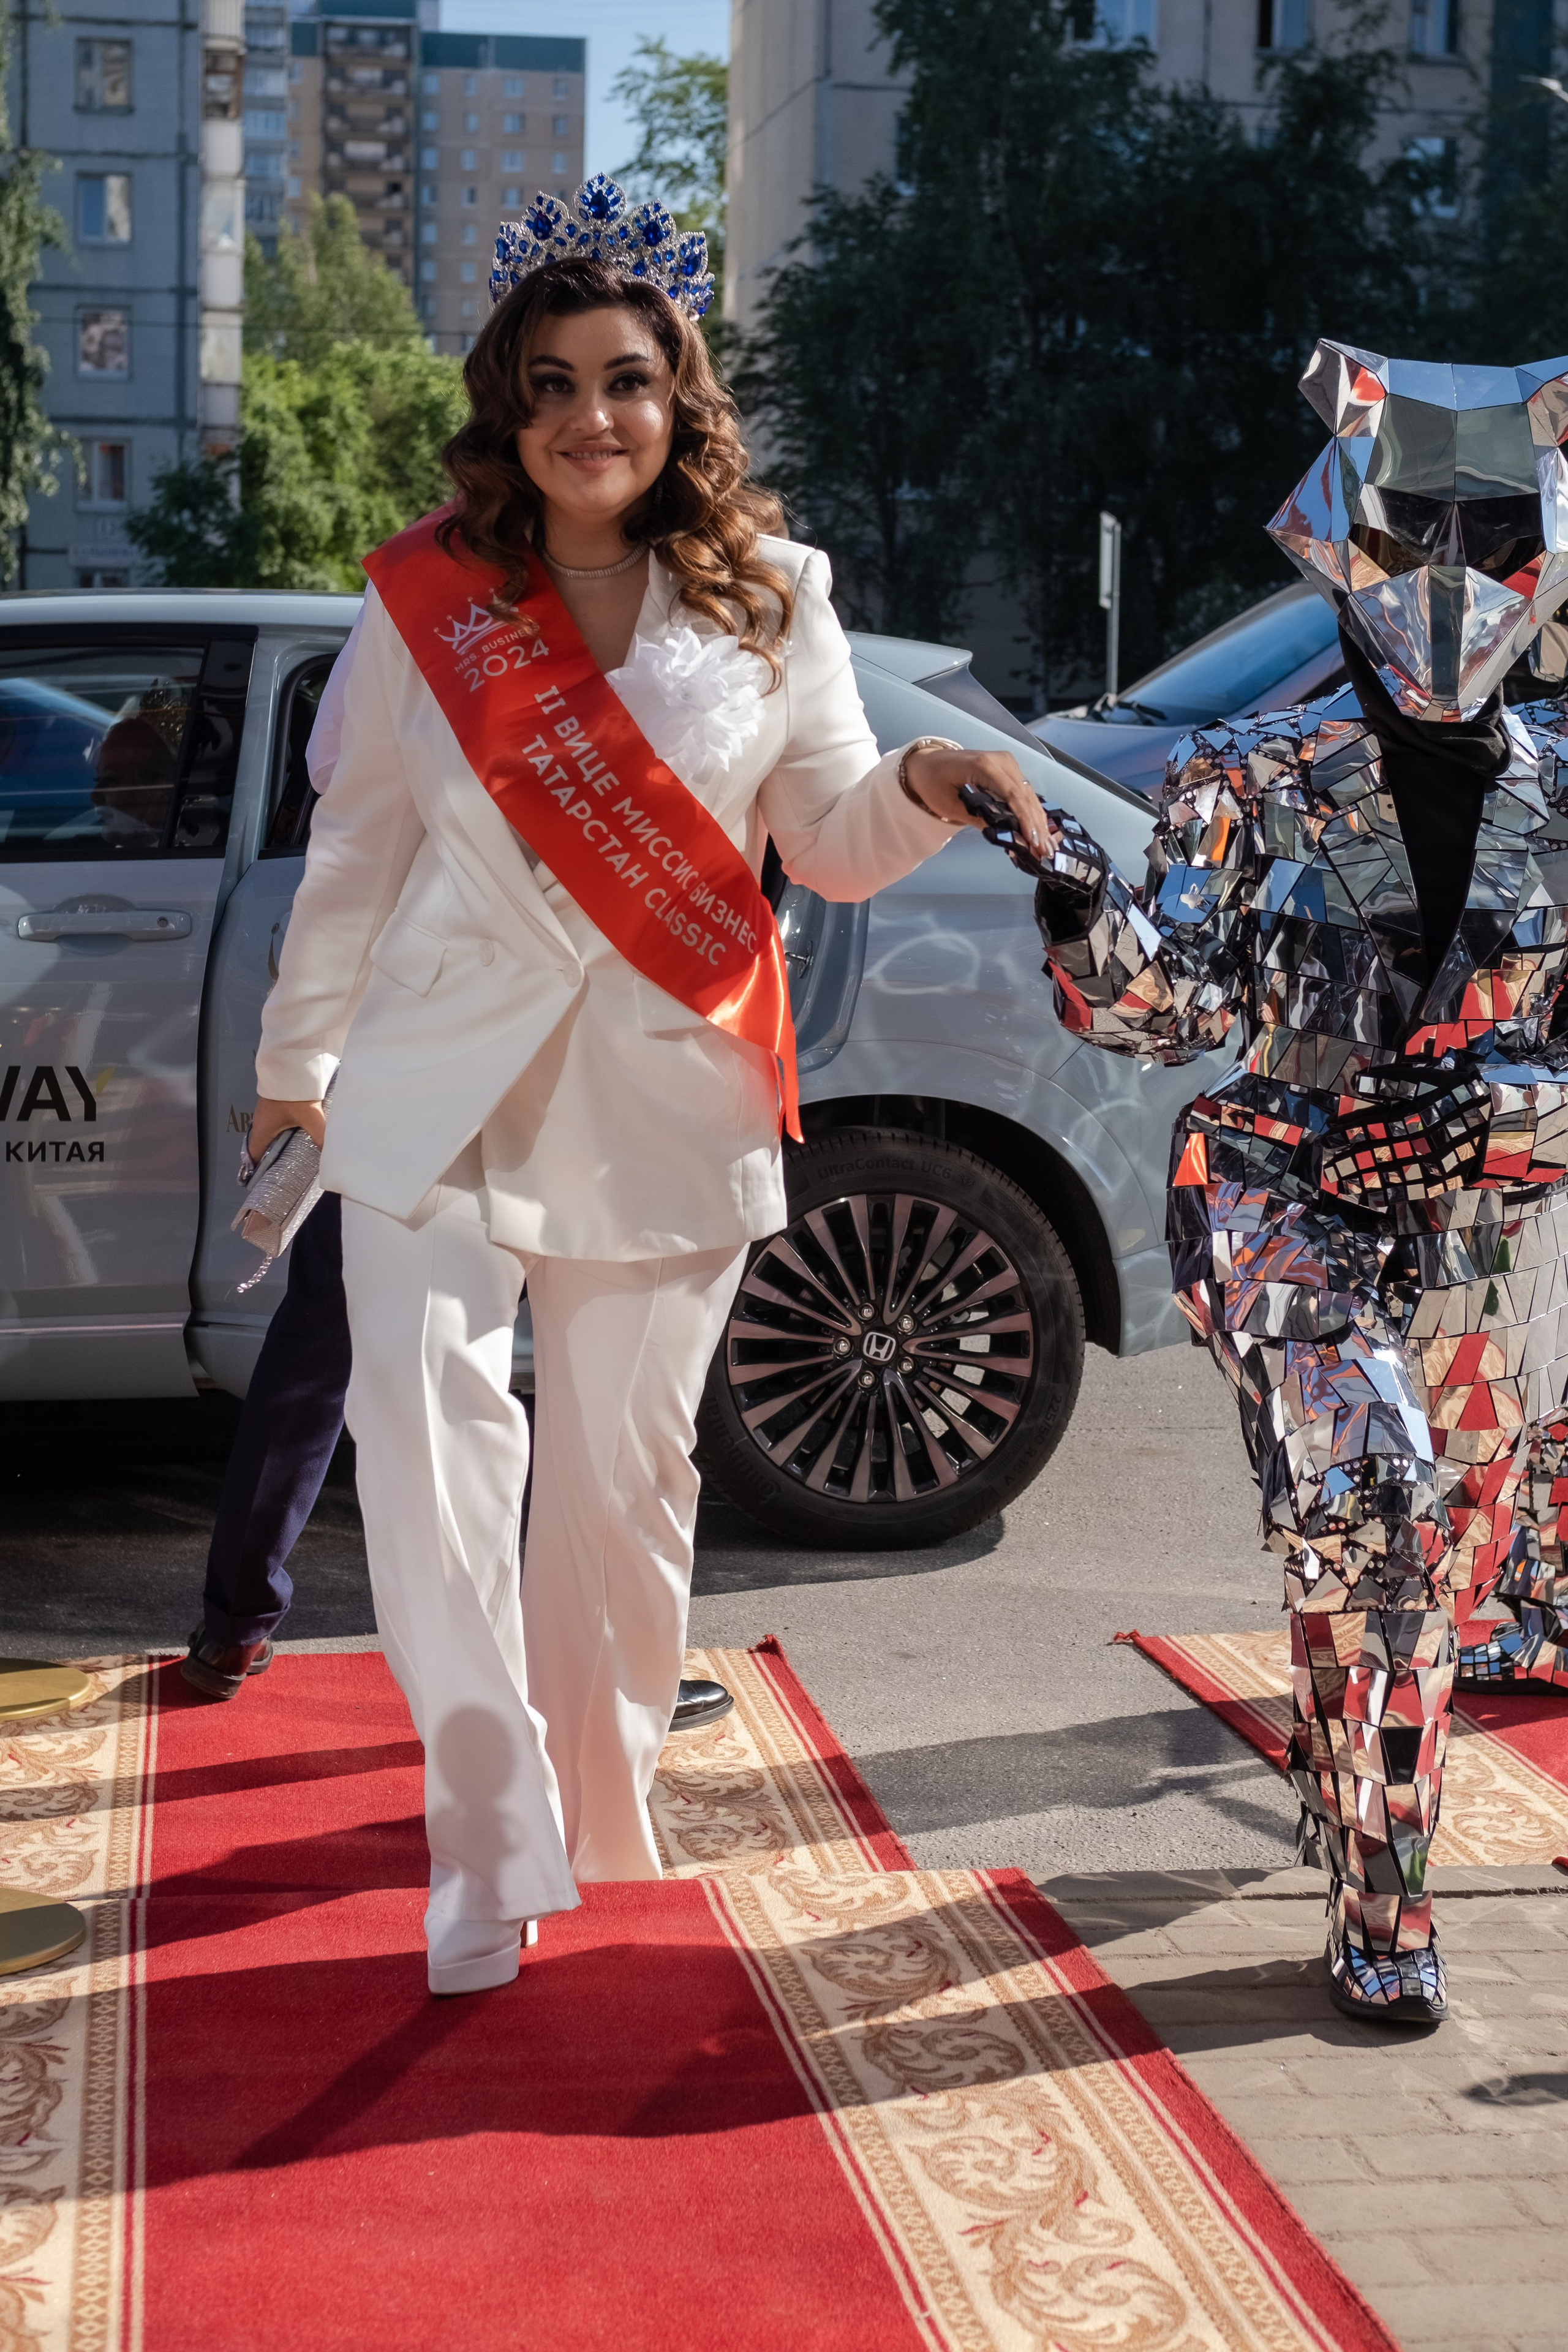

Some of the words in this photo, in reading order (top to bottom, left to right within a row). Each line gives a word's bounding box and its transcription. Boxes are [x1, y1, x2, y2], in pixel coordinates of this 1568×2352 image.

[481, 622, 540, 654] BUSINES
[464, 638, 549, 692] 2024
[522, 734, 649, 888] ТАТАРСТАН
[644, 888, 726, 965] CLASSIC
[554, 715, 620, 796] ВИЦЕ
[611, 796, 699, 891] МИССИС
[689, 881, 756, 954] БИЗНЕС
[0, 1066, 115, 1121] AY
[6, 1141, 105, 1163] КИТАЯ
[817, 1157, 915, 1180] UltraContact
[921, 1160, 952, 1178] UC6
[1033, 1393, 1062, 1446] 225/50
